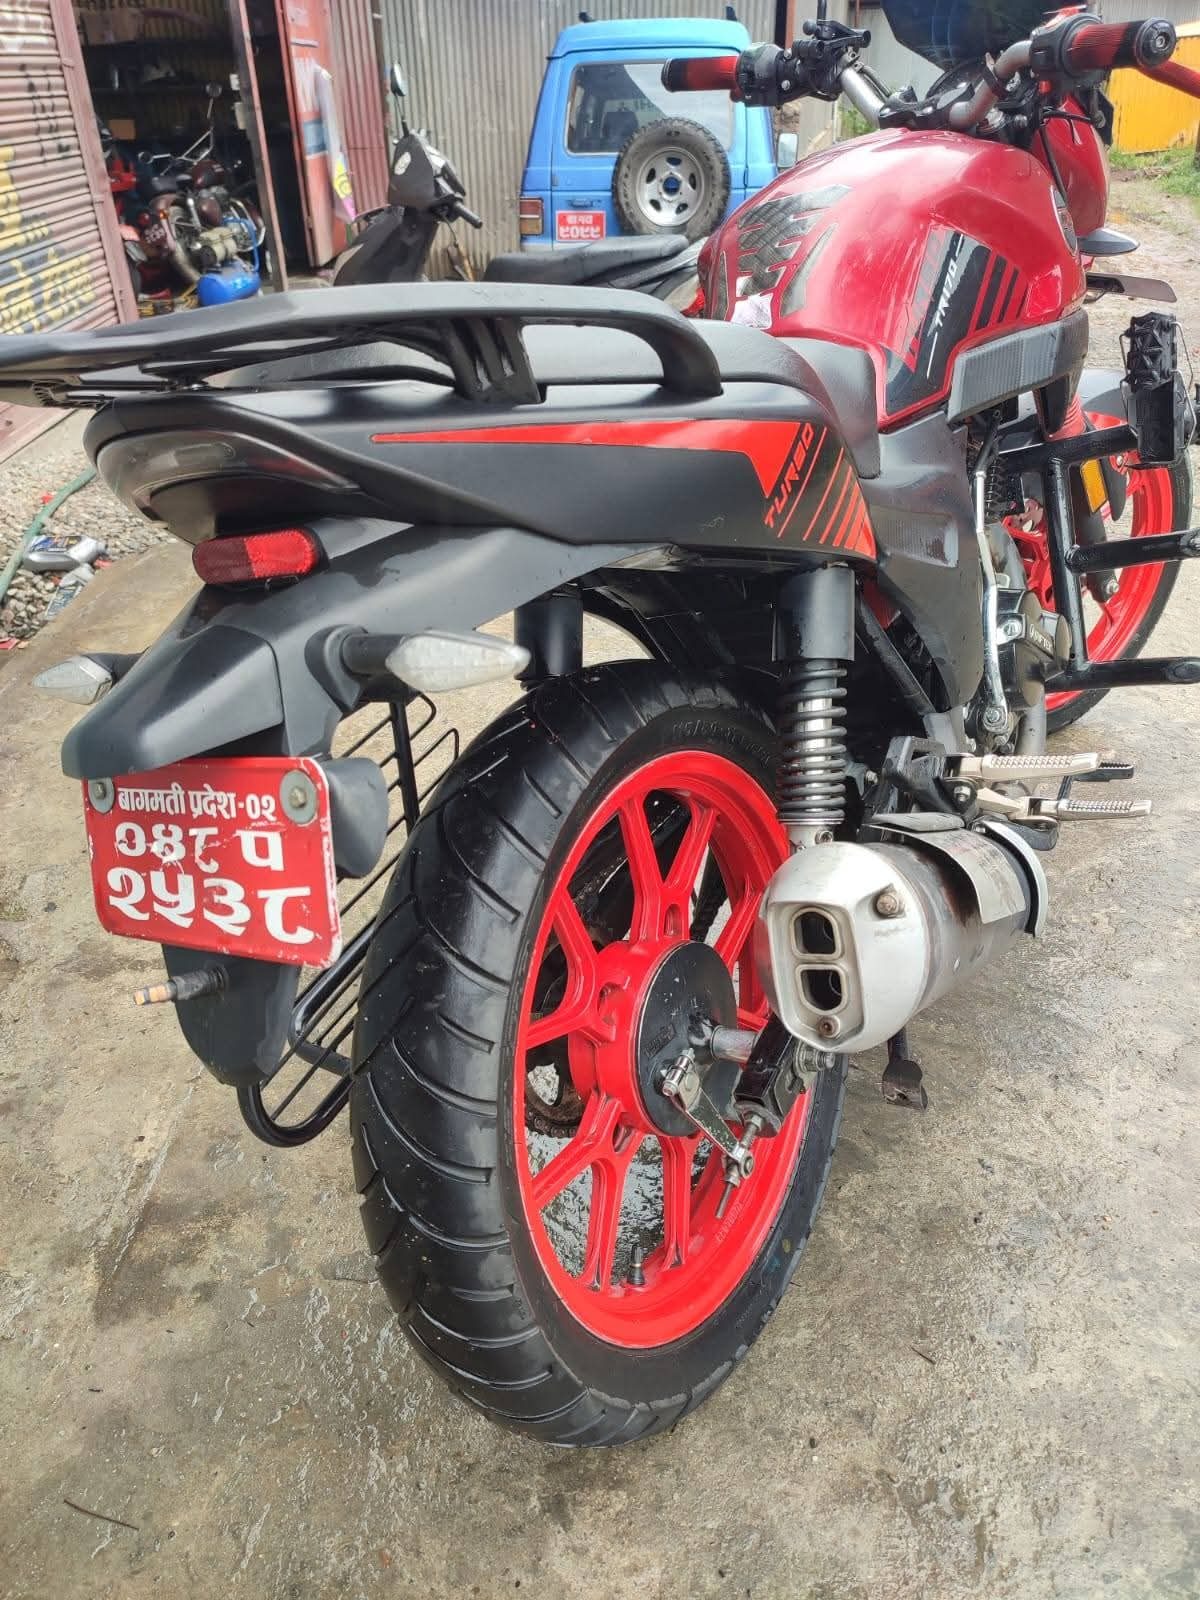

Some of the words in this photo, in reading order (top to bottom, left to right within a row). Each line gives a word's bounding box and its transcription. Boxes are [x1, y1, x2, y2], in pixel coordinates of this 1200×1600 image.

[764, 422, 815, 529] TURBO
[117, 782, 186, 815] बागमती
[115, 821, 220, 874] ०४८
[234, 828, 285, 872] प
[106, 866, 316, 945] २५३८
